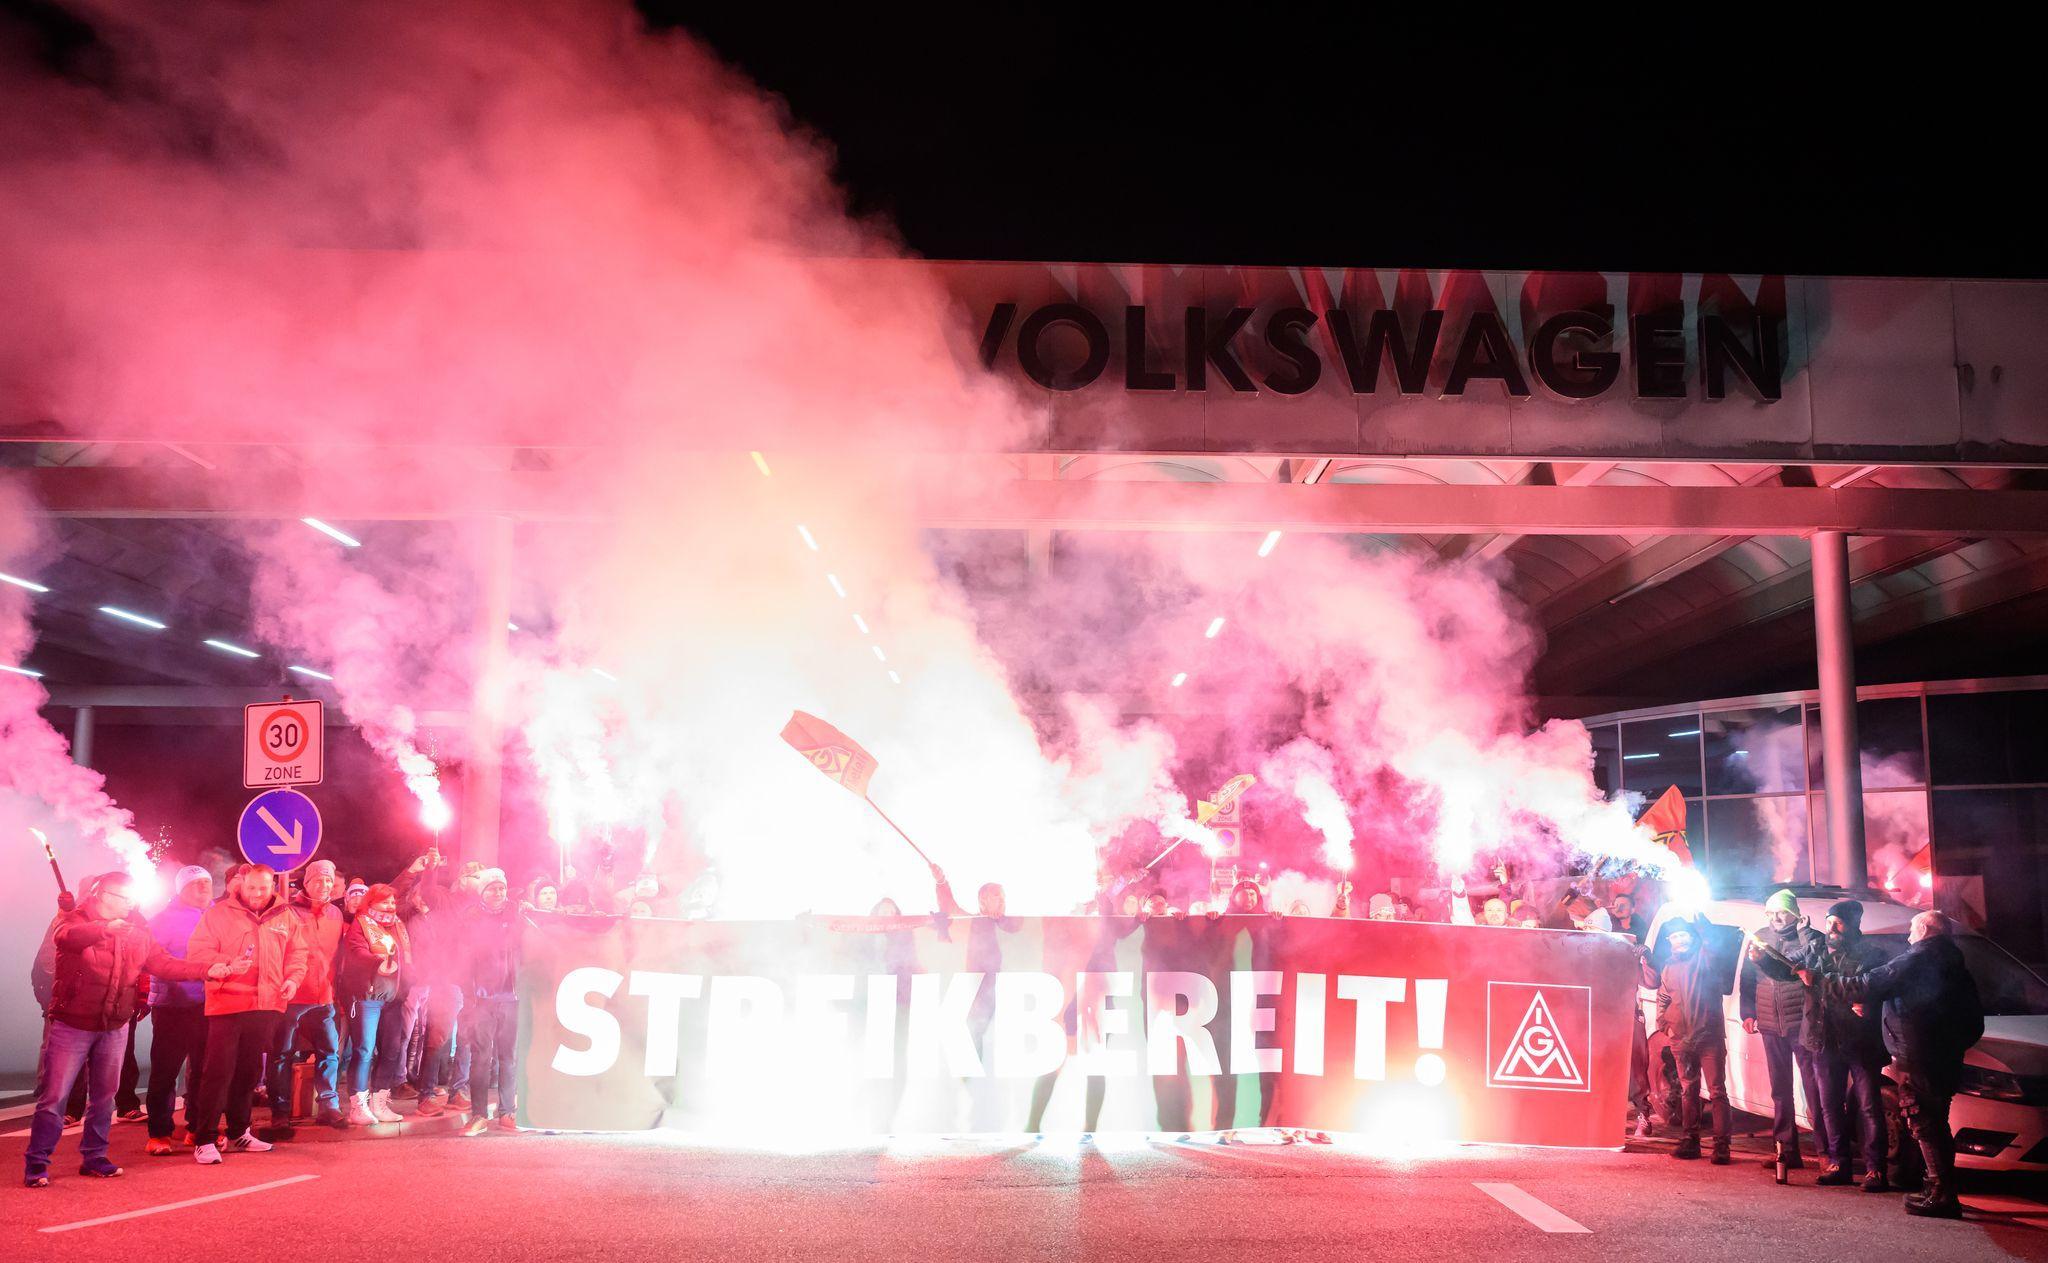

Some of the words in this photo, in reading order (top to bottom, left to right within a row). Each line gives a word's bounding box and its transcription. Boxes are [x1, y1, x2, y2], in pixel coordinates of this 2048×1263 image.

[269, 723, 298, 749] 30
[264, 765, 302, 781] ZONE
[551, 966, 1448, 1086] STREIKBEREIT!
